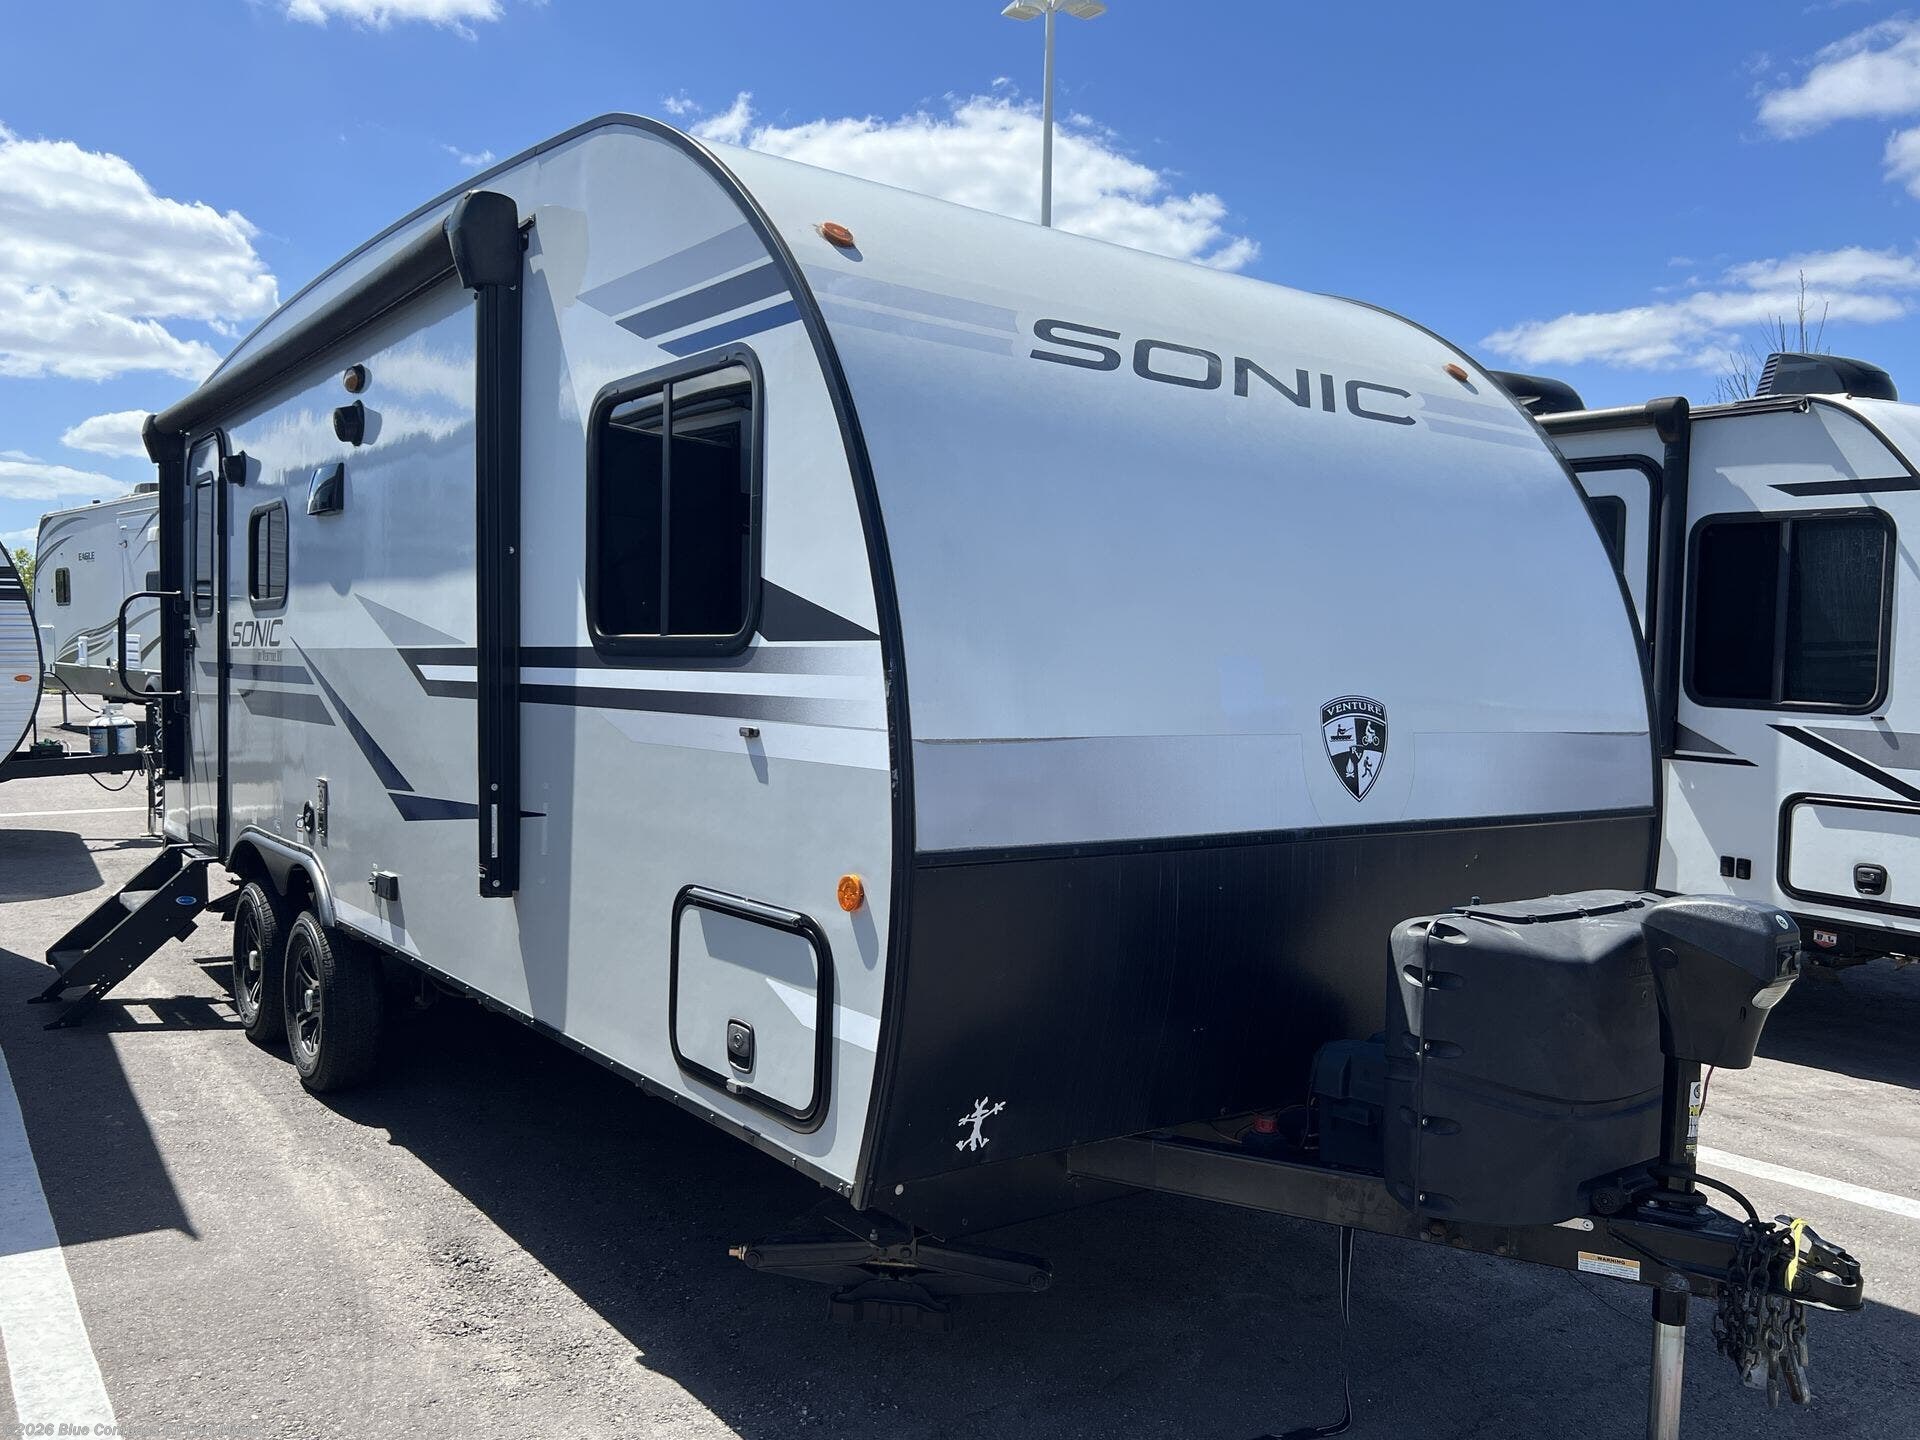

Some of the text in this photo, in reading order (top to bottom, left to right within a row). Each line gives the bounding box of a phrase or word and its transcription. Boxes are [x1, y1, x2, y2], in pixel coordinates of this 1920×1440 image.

[1029, 318, 1417, 426] SONIC
[78, 551, 95, 561] EAGLE
[231, 619, 283, 647] SONIC
[1326, 701, 1382, 716] VENTURE
[1351, 746, 1362, 760] RV
[1597, 1256, 1626, 1265] WARNING
